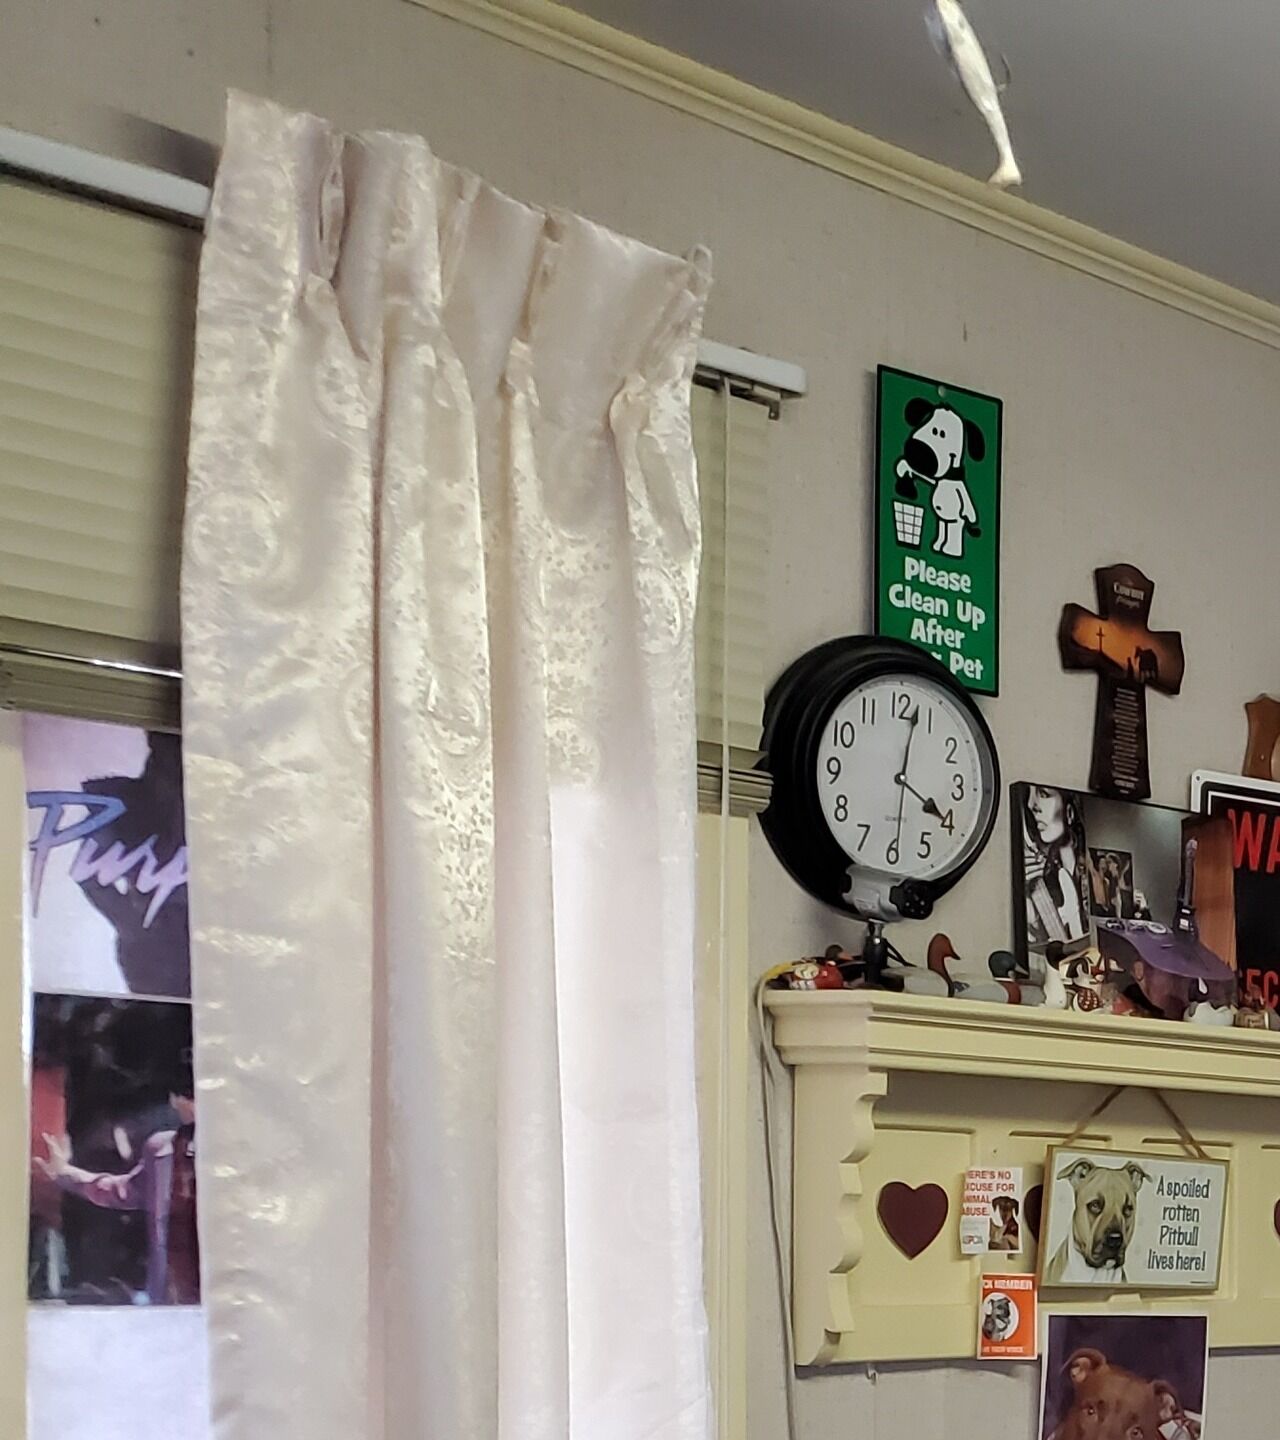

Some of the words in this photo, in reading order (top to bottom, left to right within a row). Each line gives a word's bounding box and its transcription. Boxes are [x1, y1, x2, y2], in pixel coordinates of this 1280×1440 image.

[905, 556, 971, 593] Please
[889, 584, 949, 617] Clean
[910, 618, 965, 649] After
[949, 651, 984, 680] Pet
[862, 697, 875, 725] 11
[892, 691, 912, 720] 12
[834, 720, 855, 748] 10
[945, 737, 958, 764] 2
[826, 757, 841, 784] 9
[951, 774, 964, 801] 3
[834, 794, 848, 822] 8
[941, 809, 955, 836] 4
[857, 824, 871, 851] 7
[917, 832, 932, 858] 5
[886, 838, 899, 865] 6
[1166, 1178, 1210, 1200] spoiled
[1162, 1204, 1200, 1223] rotten
[1159, 1225, 1199, 1247] Pitbull
[1147, 1250, 1175, 1271] lives
[1176, 1251, 1206, 1272] here!
